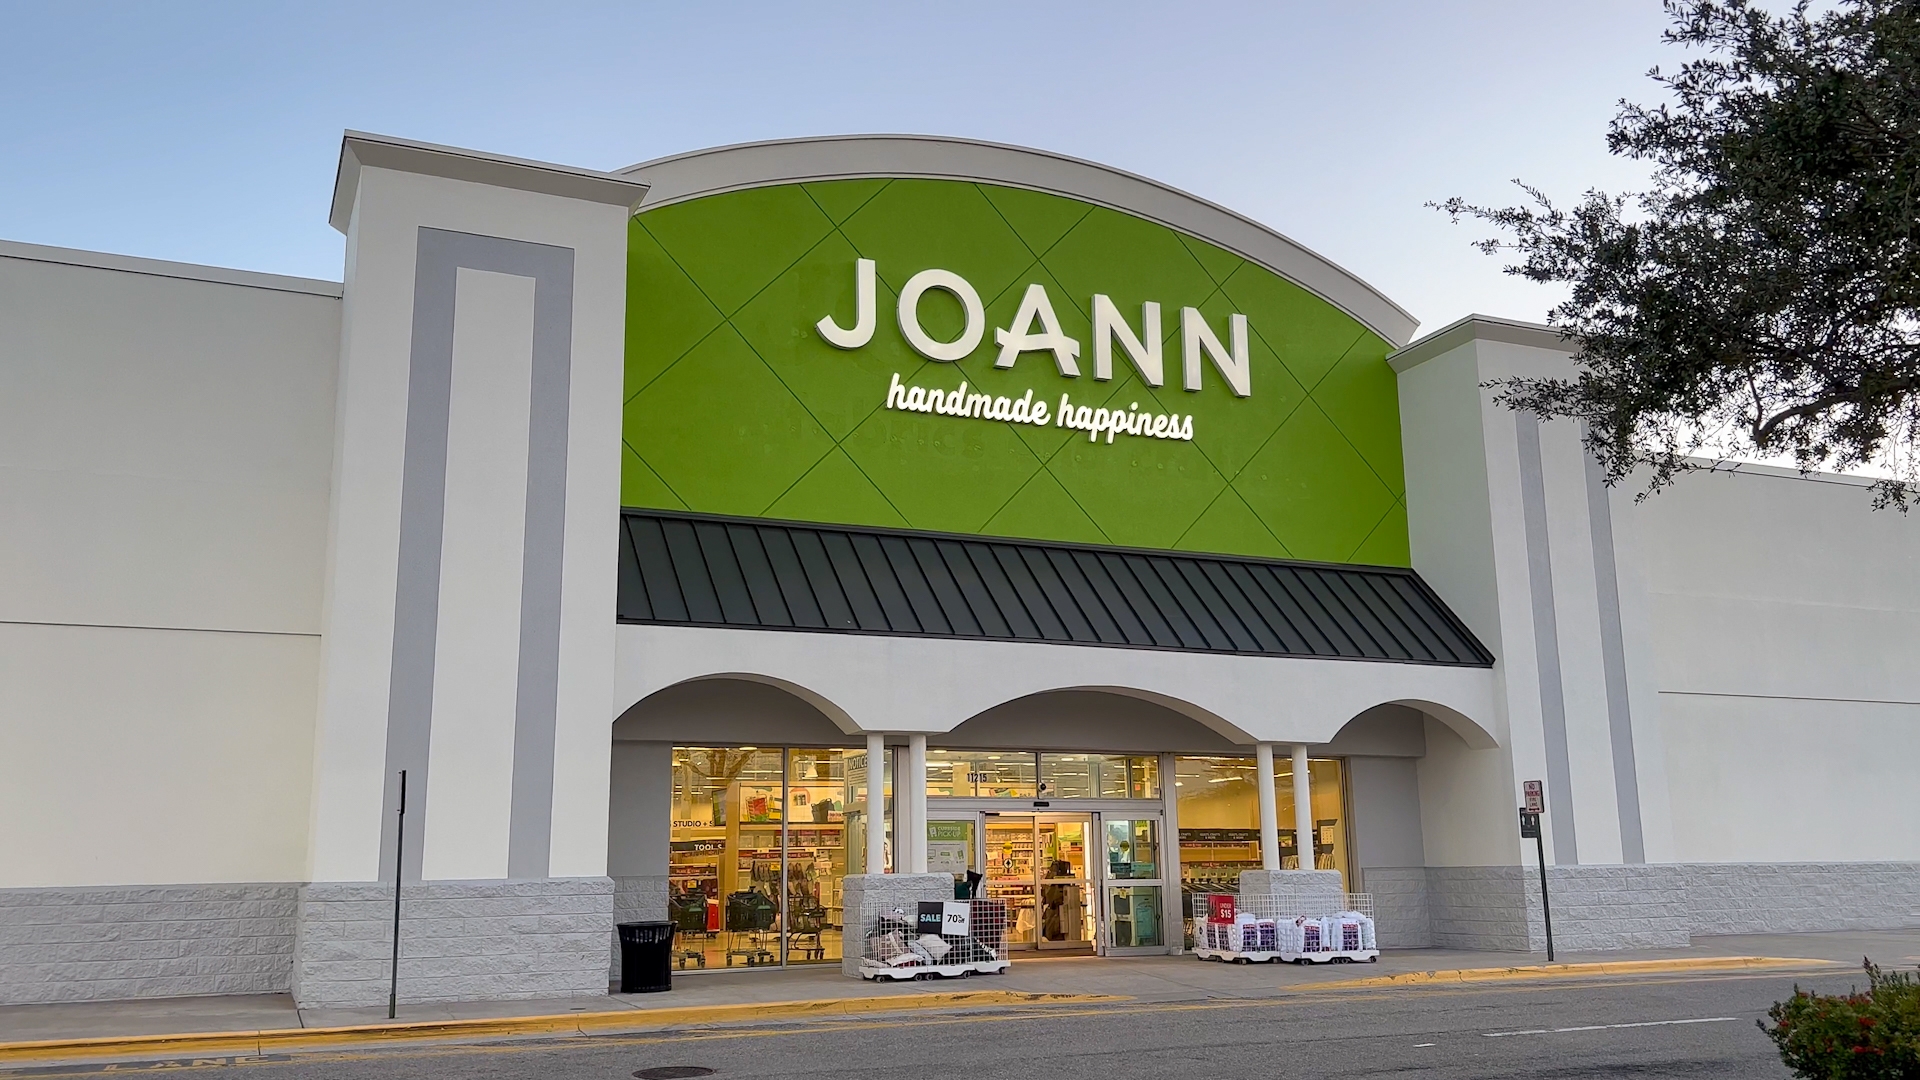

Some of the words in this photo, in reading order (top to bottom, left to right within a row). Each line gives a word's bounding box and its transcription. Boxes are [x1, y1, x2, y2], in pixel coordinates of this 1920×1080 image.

[815, 257, 1252, 398] JOANN
[886, 372, 1051, 425] handmade
[1056, 393, 1194, 444] happiness
[967, 773, 988, 783] 11215
[673, 820, 702, 828] STUDIO
[920, 914, 941, 922] SALE
[1220, 908, 1232, 919] $15
[103, 1055, 269, 1072] LANE
